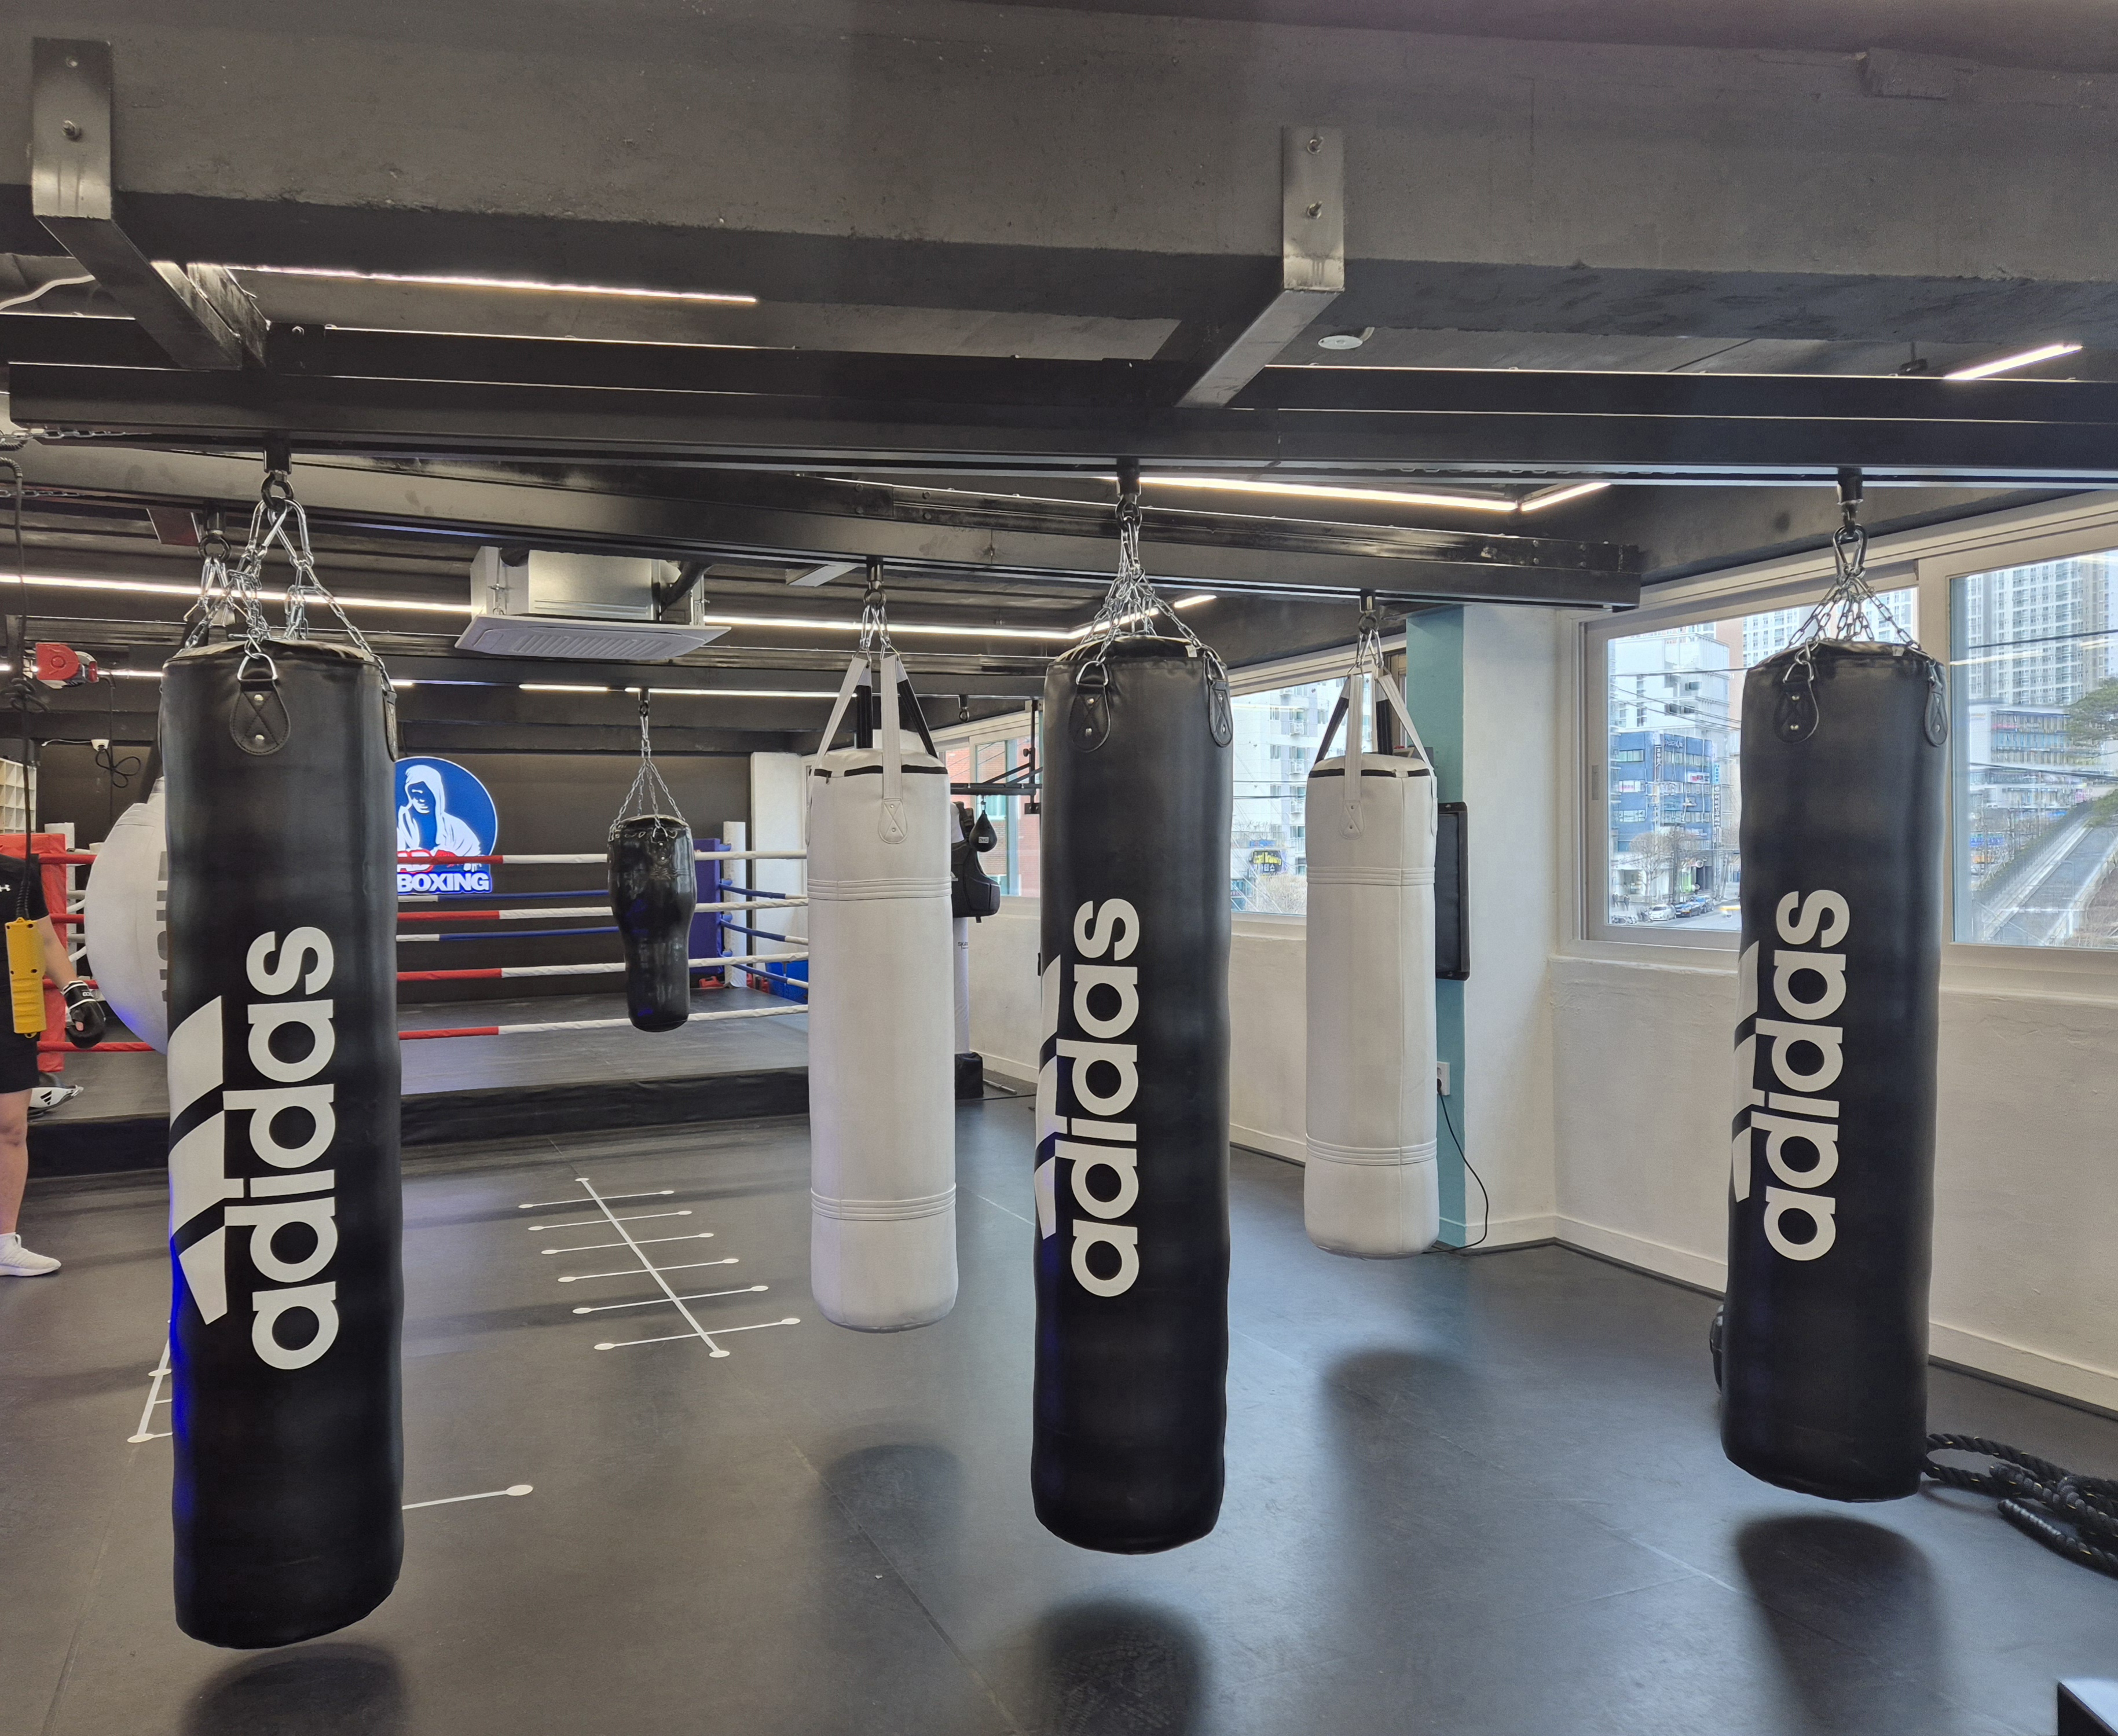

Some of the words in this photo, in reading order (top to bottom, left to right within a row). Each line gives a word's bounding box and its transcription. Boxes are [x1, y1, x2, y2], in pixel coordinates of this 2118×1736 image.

[397, 873, 489, 892] BOXING
[223, 926, 339, 1369] adidas
[1055, 898, 1139, 1297] adidas
[1751, 890, 1850, 1261] adidas
